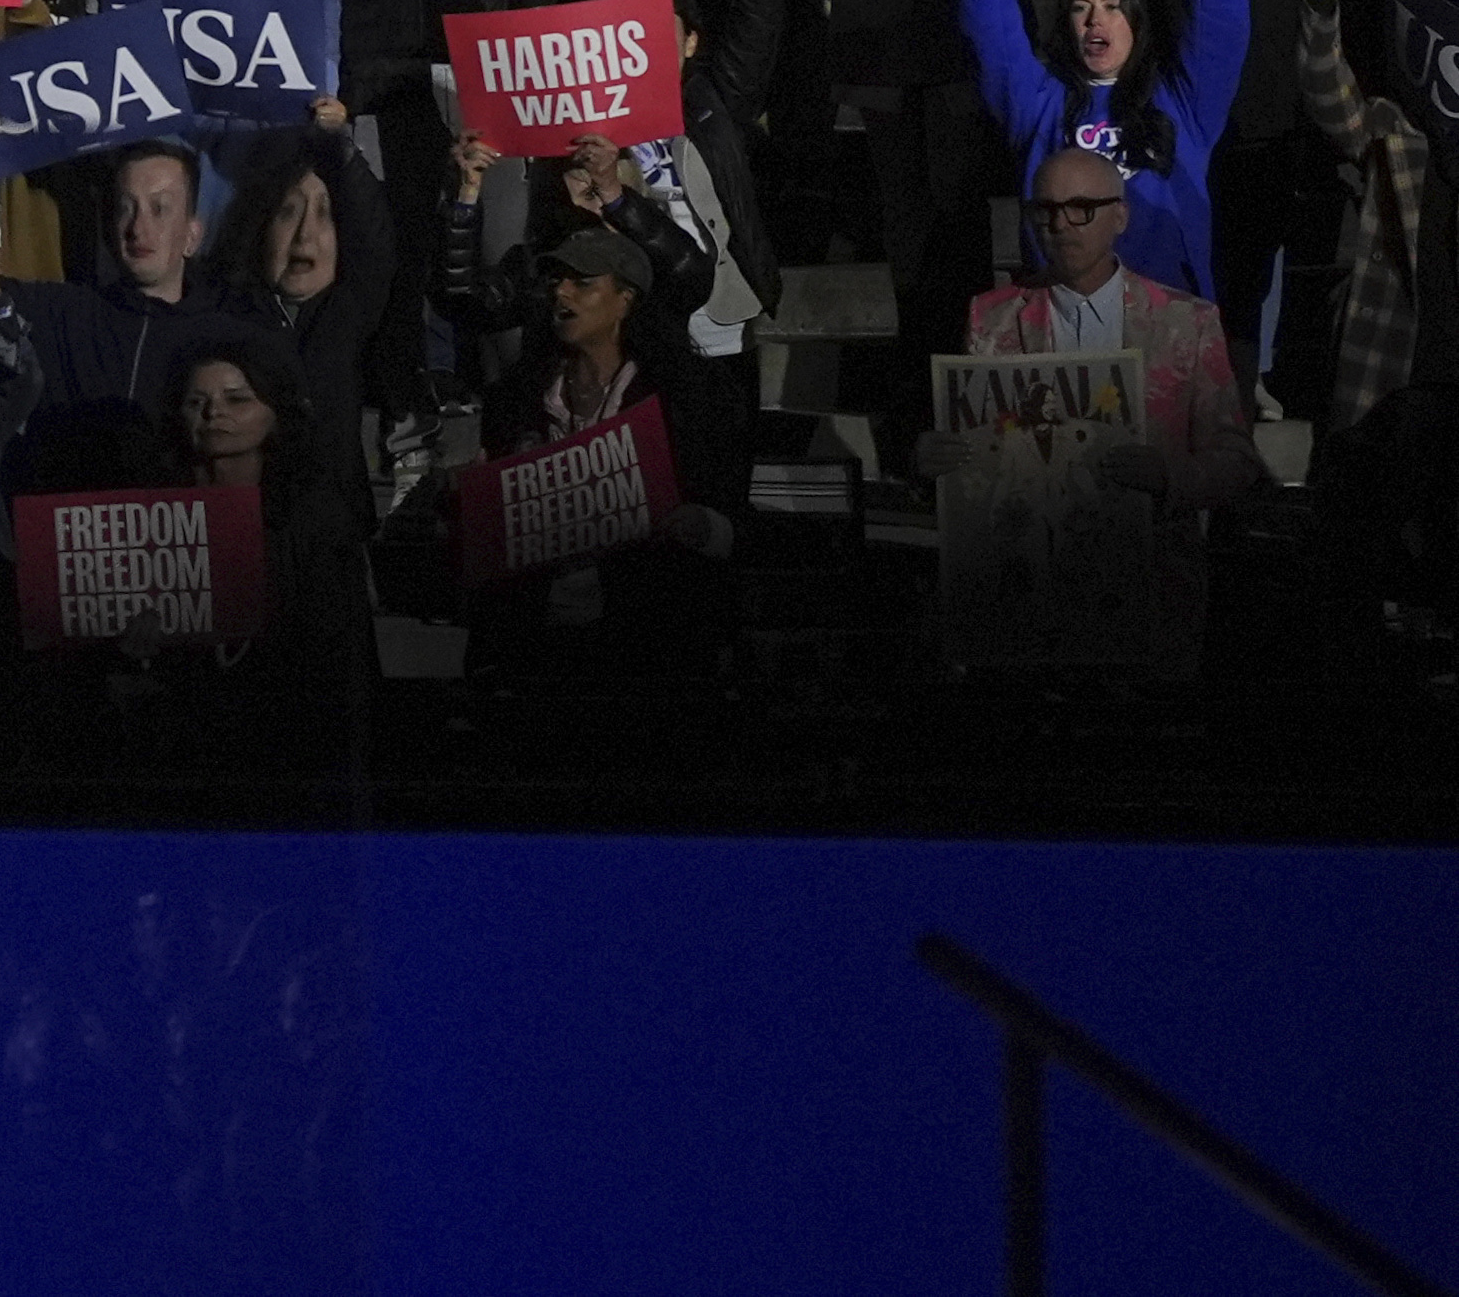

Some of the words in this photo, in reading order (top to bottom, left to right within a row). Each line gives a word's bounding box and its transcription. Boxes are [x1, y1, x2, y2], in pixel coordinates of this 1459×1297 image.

[479, 21, 648, 91] HARRIS
[512, 84, 630, 125] WALZ
[55, 501, 207, 550] FREEDOM
[58, 547, 210, 593] FREEDOM
